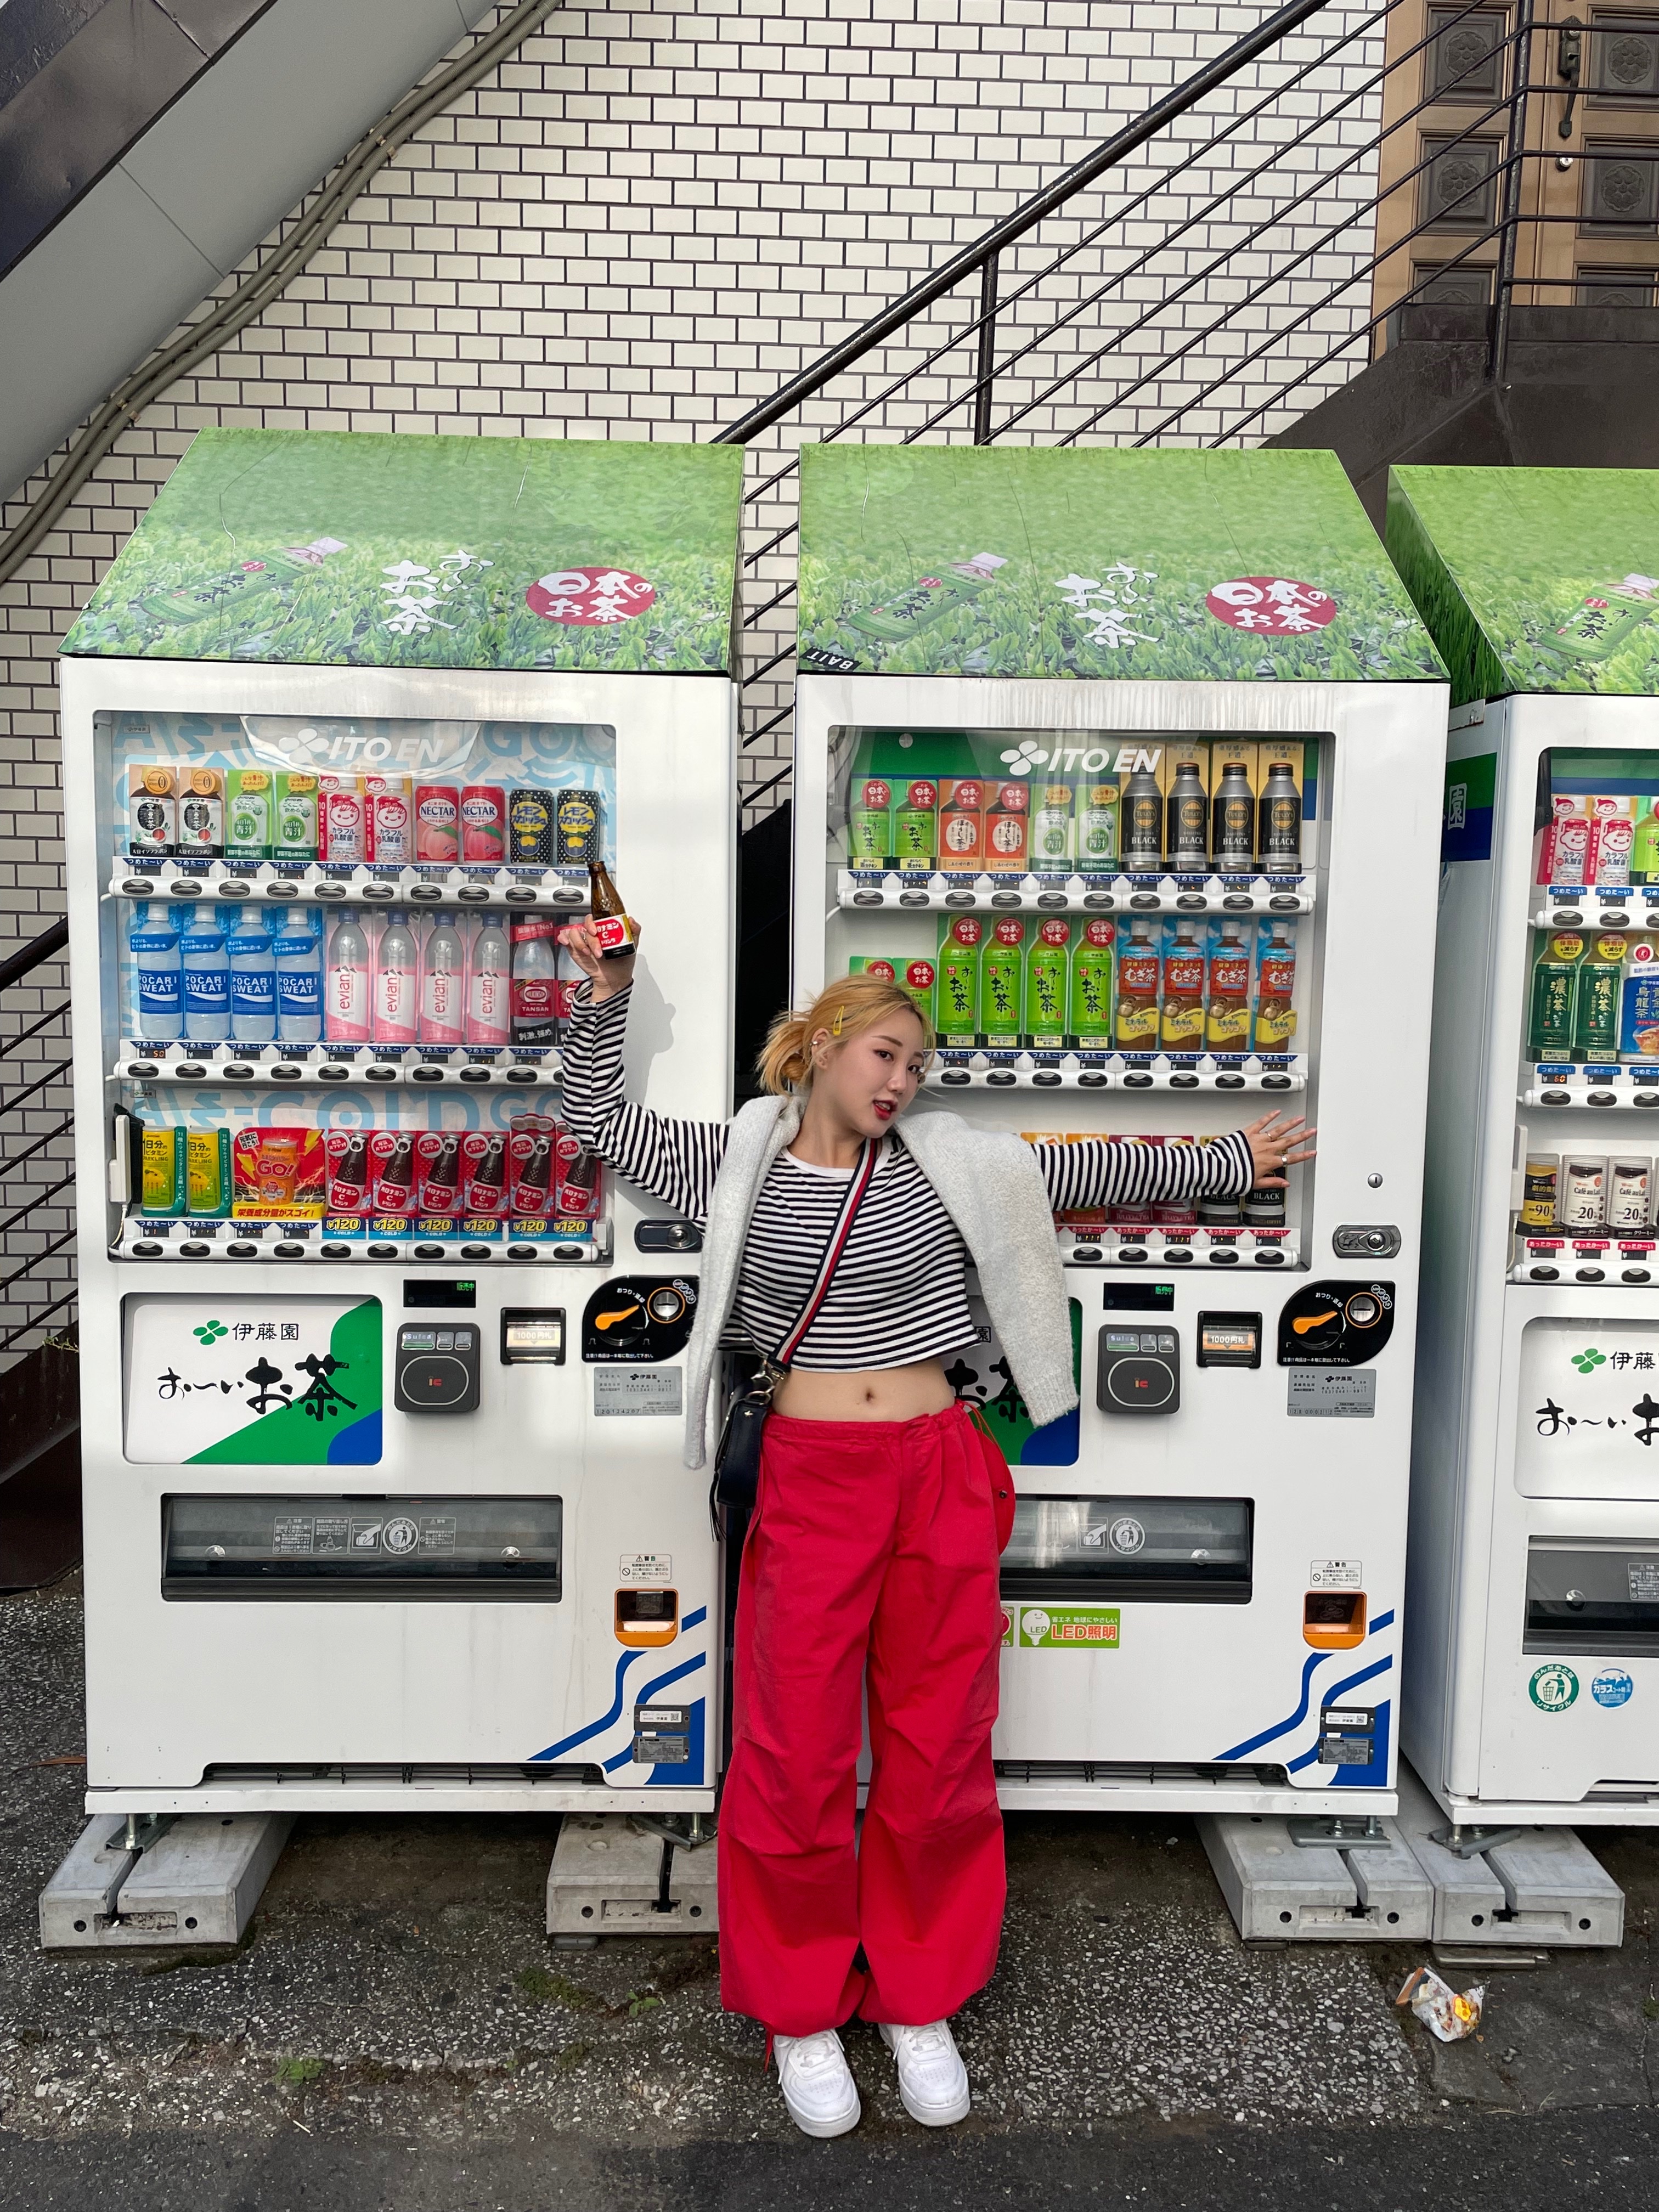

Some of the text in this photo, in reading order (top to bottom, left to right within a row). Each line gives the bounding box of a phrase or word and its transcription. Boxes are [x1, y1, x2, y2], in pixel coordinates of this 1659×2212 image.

[538, 569, 656, 600] 日本の
[1210, 580, 1328, 607] 日本の
[544, 596, 637, 622] お茶
[1233, 605, 1325, 633] お茶
[806, 651, 854, 670] BAIT
[329, 736, 444, 762] ITO EN
[1048, 748, 1161, 772] ITO EN
[421, 806, 455, 816] NECTAR
[463, 806, 495, 816] NECTAR
[517, 806, 542, 815] レモン
[565, 807, 589, 816] レモン
[1448, 782, 1468, 830] 園
[236, 825, 253, 834] 青汁
[285, 827, 301, 837] 青汁
[1131, 837, 1157, 845] BLACK
[1179, 837, 1204, 845] BLACK
[1223, 837, 1249, 845] BLACK
[1269, 838, 1295, 846] BLACK
[596, 922, 619, 933] ロナミン
[139, 975, 177, 984] POCARI
[185, 975, 226, 984] POCARI
[1125, 967, 1156, 983] むぎ茶
[1170, 968, 1201, 983] むぎ茶
[1216, 969, 1247, 984] むぎ茶
[232, 977, 272, 985] POCARI
[279, 977, 317, 986] POCARI
[139, 984, 173, 992] SWEAT
[186, 983, 223, 991] SWEAT
[233, 985, 269, 993] SWEAT
[279, 985, 314, 994] SWEAT
[340, 971, 350, 1011] evian
[387, 977, 398, 1013] evian
[435, 977, 445, 1013] evian
[482, 978, 493, 1014] evian
[949, 977, 970, 1012] お茶
[991, 977, 1012, 1012] お茶
[1036, 978, 1058, 1013] お茶
[1082, 978, 1103, 1013] お茶
[1550, 976, 1568, 1012] 濃い茶
[1594, 977, 1612, 1012] 濃い茶
[239, 1133, 257, 1142] 元気に
[257, 1160, 296, 1176] GO!
[334, 1186, 358, 1196] オロナミン
[381, 1187, 405, 1197] オロナミン
[427, 1187, 451, 1197] オロナミン
[473, 1187, 497, 1197] オロナミン
[518, 1188, 542, 1199] オロナミン
[565, 1188, 588, 1199] オロナミン
[1535, 1204, 1549, 1217] 90
[1578, 1207, 1593, 1219] 20
[1623, 1207, 1639, 1220] 20
[328, 1219, 359, 1230] ¥120
[374, 1219, 406, 1231] ¥120
[420, 1220, 452, 1231] ¥120
[465, 1220, 496, 1231] ¥120
[514, 1221, 546, 1232] ¥120
[555, 1221, 586, 1232] ¥120
[456, 1282, 475, 1291] 販売中
[1155, 1286, 1173, 1295] 販売中
[232, 1322, 300, 1341] 伊藤園
[517, 1331, 552, 1340] 1000円札
[974, 1326, 991, 1343] 園
[1211, 1335, 1245, 1344] 1000円札
[1610, 1351, 1659, 1370] 伊藤
[388, 1544, 413, 1552] リサイクル
[1116, 1543, 1140, 1552] リサイクル
[1051, 1625, 1118, 1640] LED照明
[1534, 1664, 1575, 1680] のんだあとは
[1536, 1699, 1571, 1711] リサイクル
